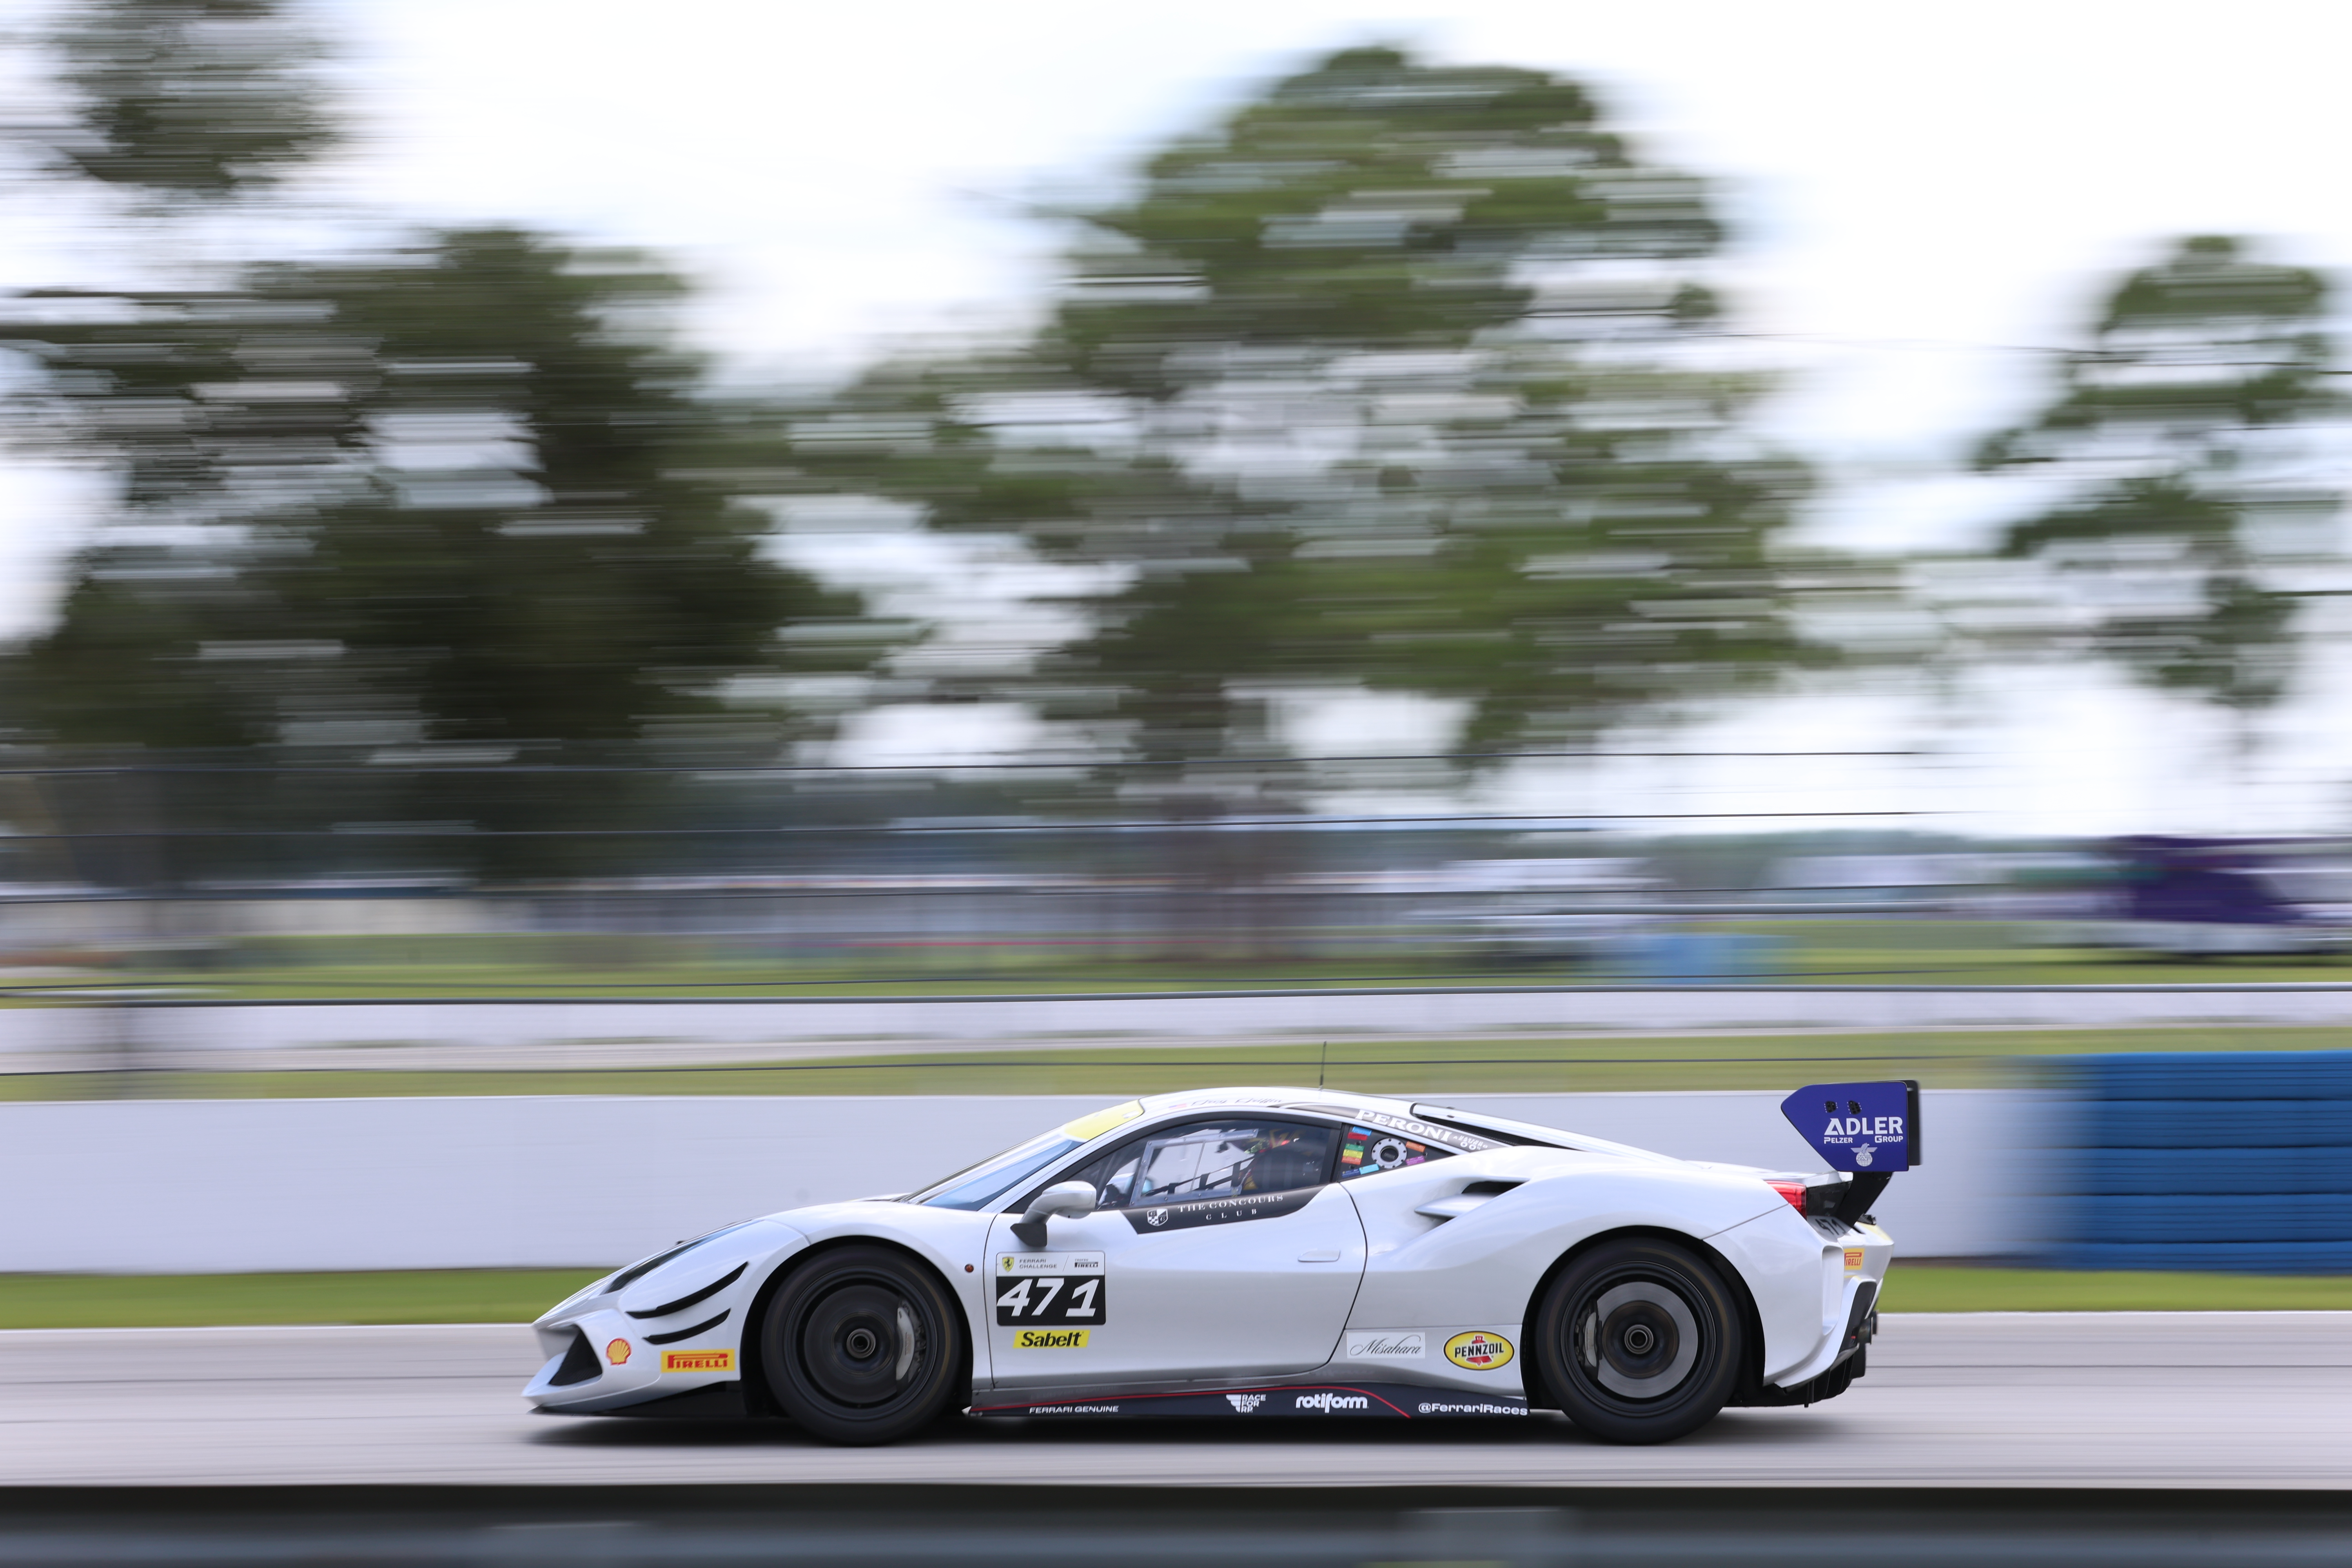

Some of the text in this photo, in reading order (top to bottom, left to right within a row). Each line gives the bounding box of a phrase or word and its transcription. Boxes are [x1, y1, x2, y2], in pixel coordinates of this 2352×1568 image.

[1355, 1109, 1453, 1142] PERONI
[1824, 1117, 1903, 1135] ADLER
[1178, 1194, 1283, 1213] THE CONCOURS
[1206, 1209, 1257, 1220] CLUB
[1844, 1252, 1862, 1266] PIRELLI
[996, 1278, 1100, 1317] 471
[1021, 1331, 1082, 1347] Sabelt
[1350, 1334, 1422, 1356] Misahara
[1454, 1342, 1504, 1358] PENNZOIL
[668, 1353, 728, 1368] PIRELLI
[1296, 1393, 1368, 1413] rotiform
[1418, 1402, 1528, 1416] @FerrariRaces
